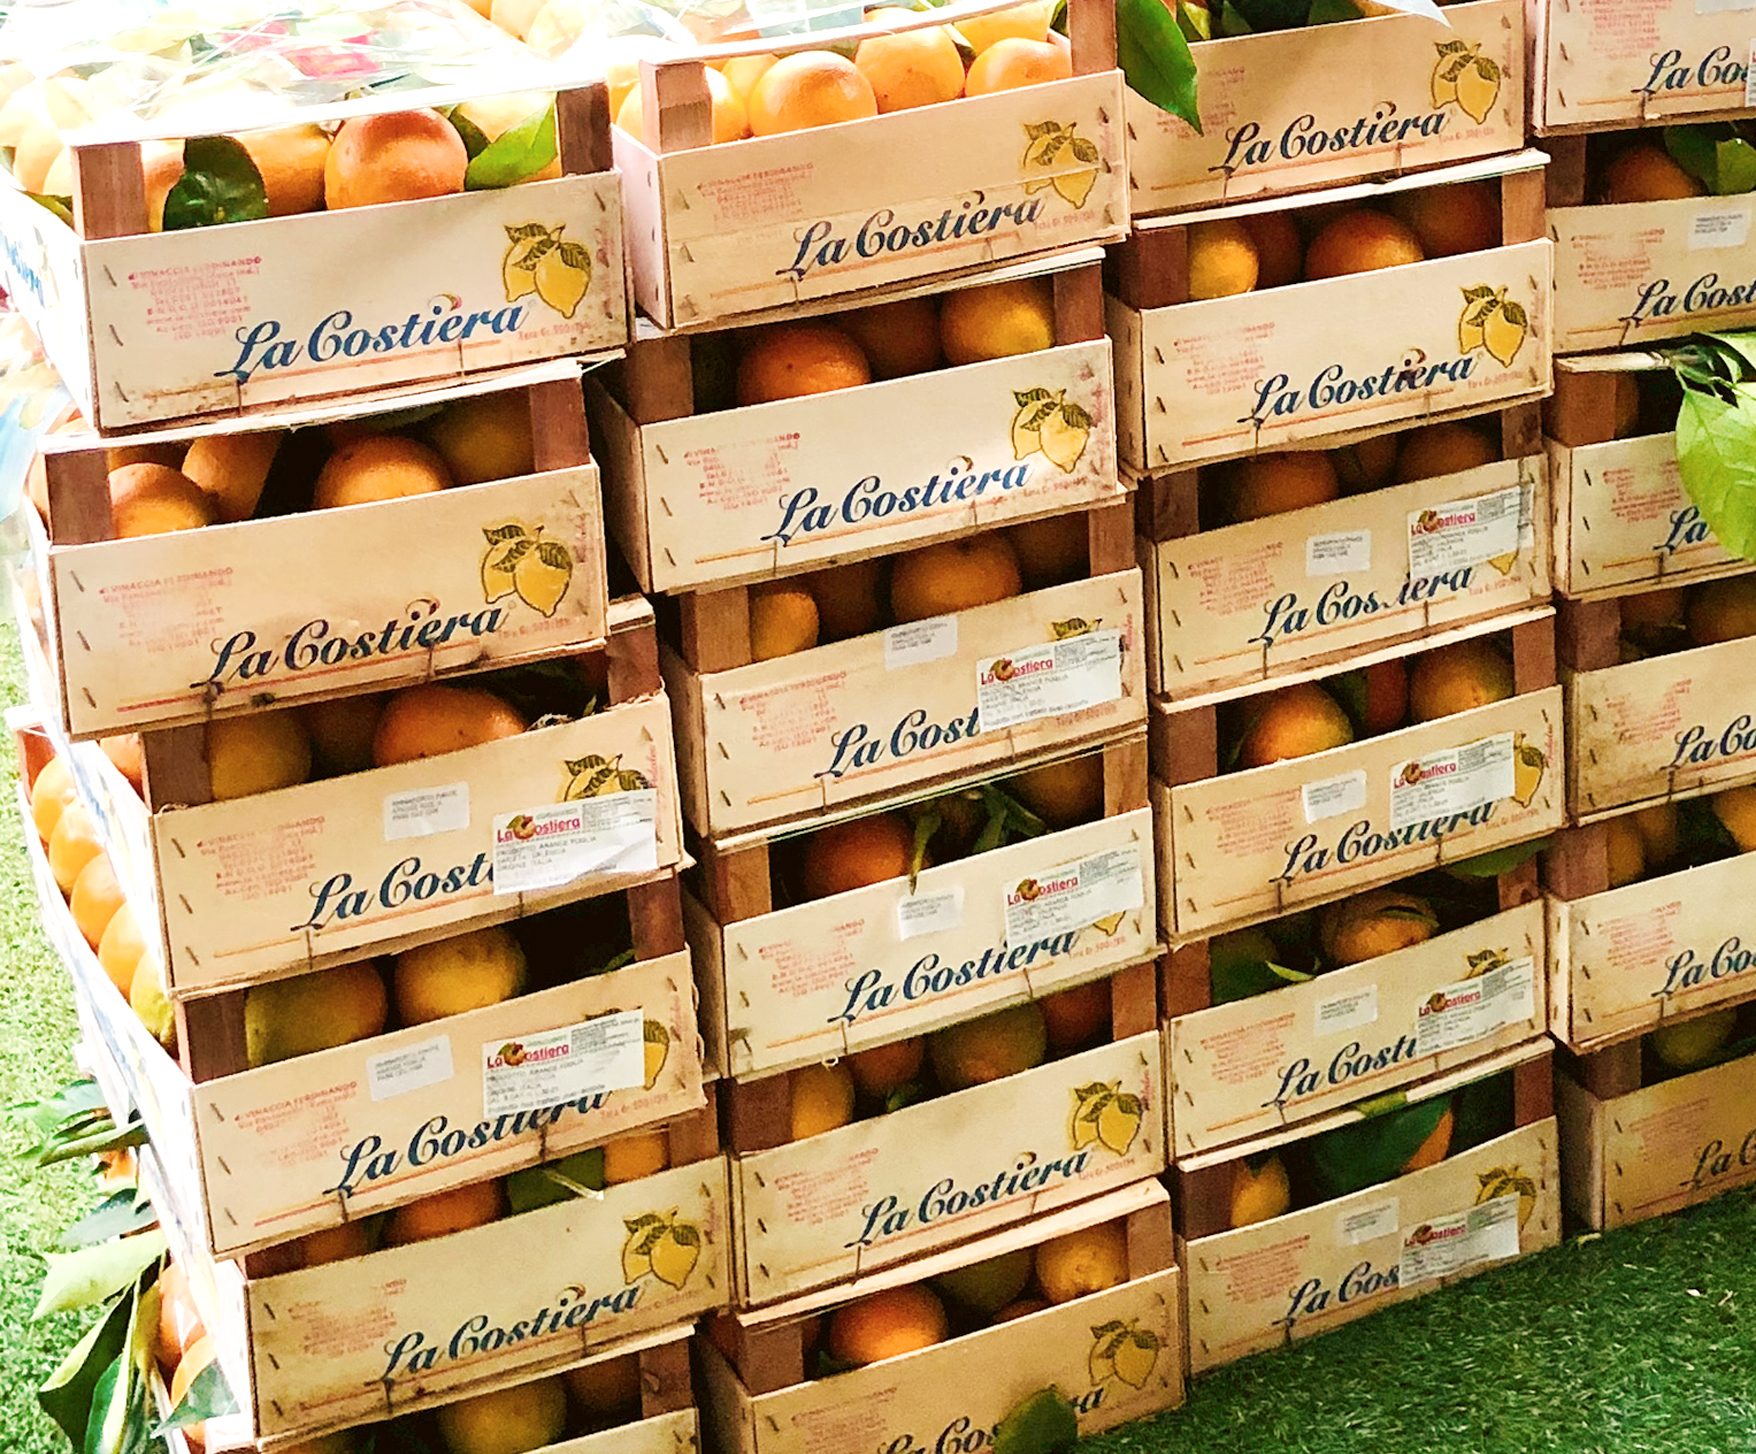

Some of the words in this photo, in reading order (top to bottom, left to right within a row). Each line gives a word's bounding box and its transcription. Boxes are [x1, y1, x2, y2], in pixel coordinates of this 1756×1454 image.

[1631, 50, 1694, 100] La
[1208, 122, 1276, 177] La
[1280, 102, 1450, 158] Costiera
[776, 220, 852, 281] La
[856, 191, 1045, 258] Costiera
[1619, 279, 1679, 328] La
[213, 321, 301, 384] La
[307, 294, 529, 362] Costiera
[1237, 373, 1305, 427] La
[1309, 349, 1480, 409] Costiera
[760, 486, 839, 546] La
[842, 457, 1033, 523] Costiera
[1653, 506, 1711, 556] La
[1248, 593, 1314, 646] La
[1317, 567, 1476, 625] Cosiera
[189, 631, 278, 696] La
[284, 597, 507, 670] Costiera
[814, 724, 886, 779] La
[1660, 725, 1717, 770] La
[1269, 834, 1334, 886] La
[290, 872, 374, 935] La
[827, 969, 899, 1023] La
[903, 930, 1081, 1000] Costiera
[1651, 950, 1708, 1000] La
[1261, 1059, 1326, 1110] La
[323, 1136, 404, 1199] La
[1680, 1141, 1736, 1189] La
[844, 1196, 916, 1248] La
[919, 1151, 1094, 1223] Costiera
[364, 1332, 448, 1384] La
[448, 1282, 647, 1359] Costiera
[1272, 1279, 1334, 1326] La
